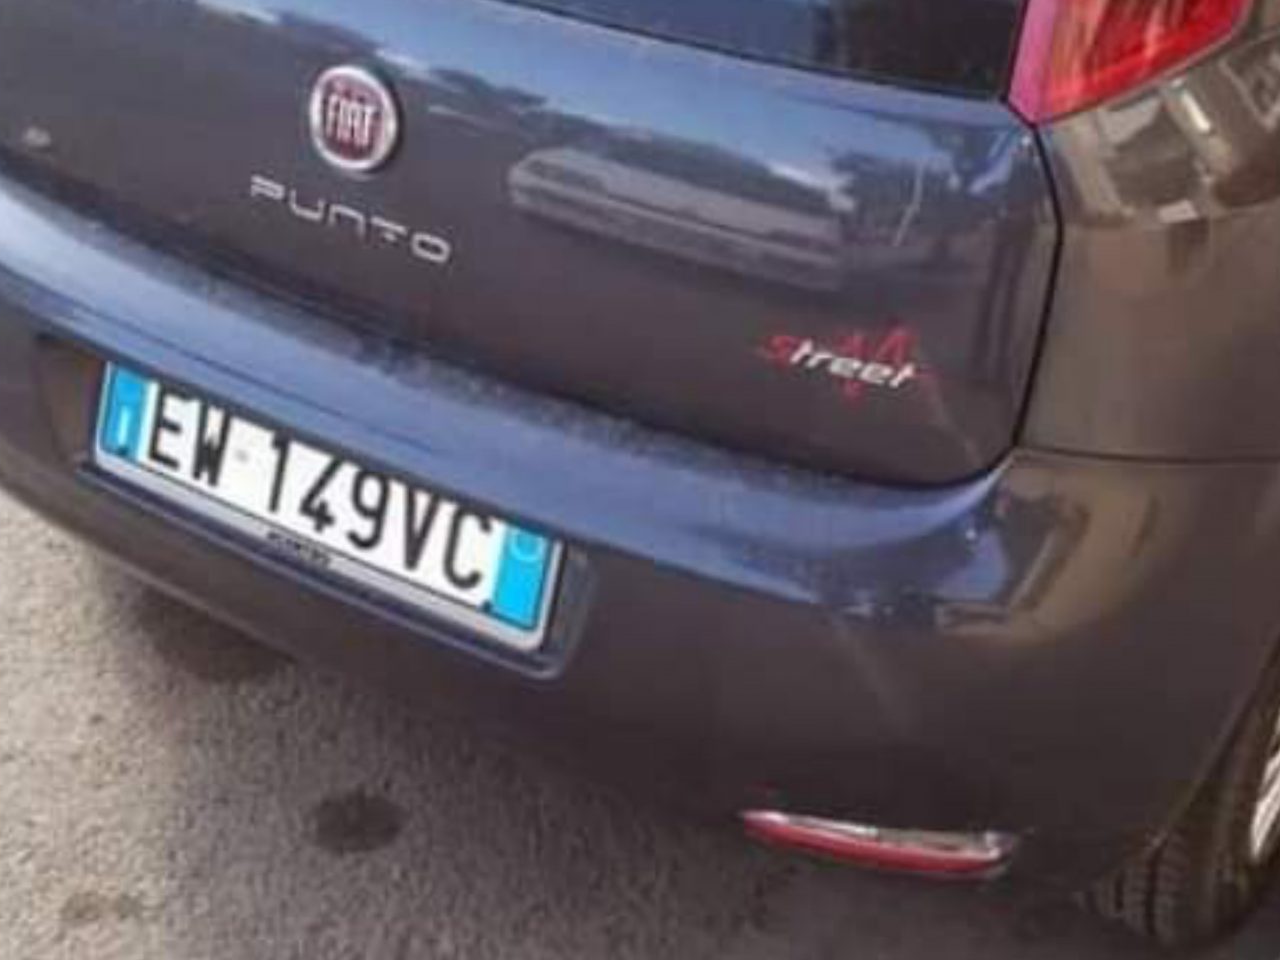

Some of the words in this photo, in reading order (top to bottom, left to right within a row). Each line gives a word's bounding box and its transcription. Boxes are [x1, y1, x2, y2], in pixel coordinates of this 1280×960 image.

[325, 91, 377, 147] FIAT
[250, 173, 452, 264] PUNTO
[148, 383, 231, 487] EW
[269, 435, 493, 591] 149VC
